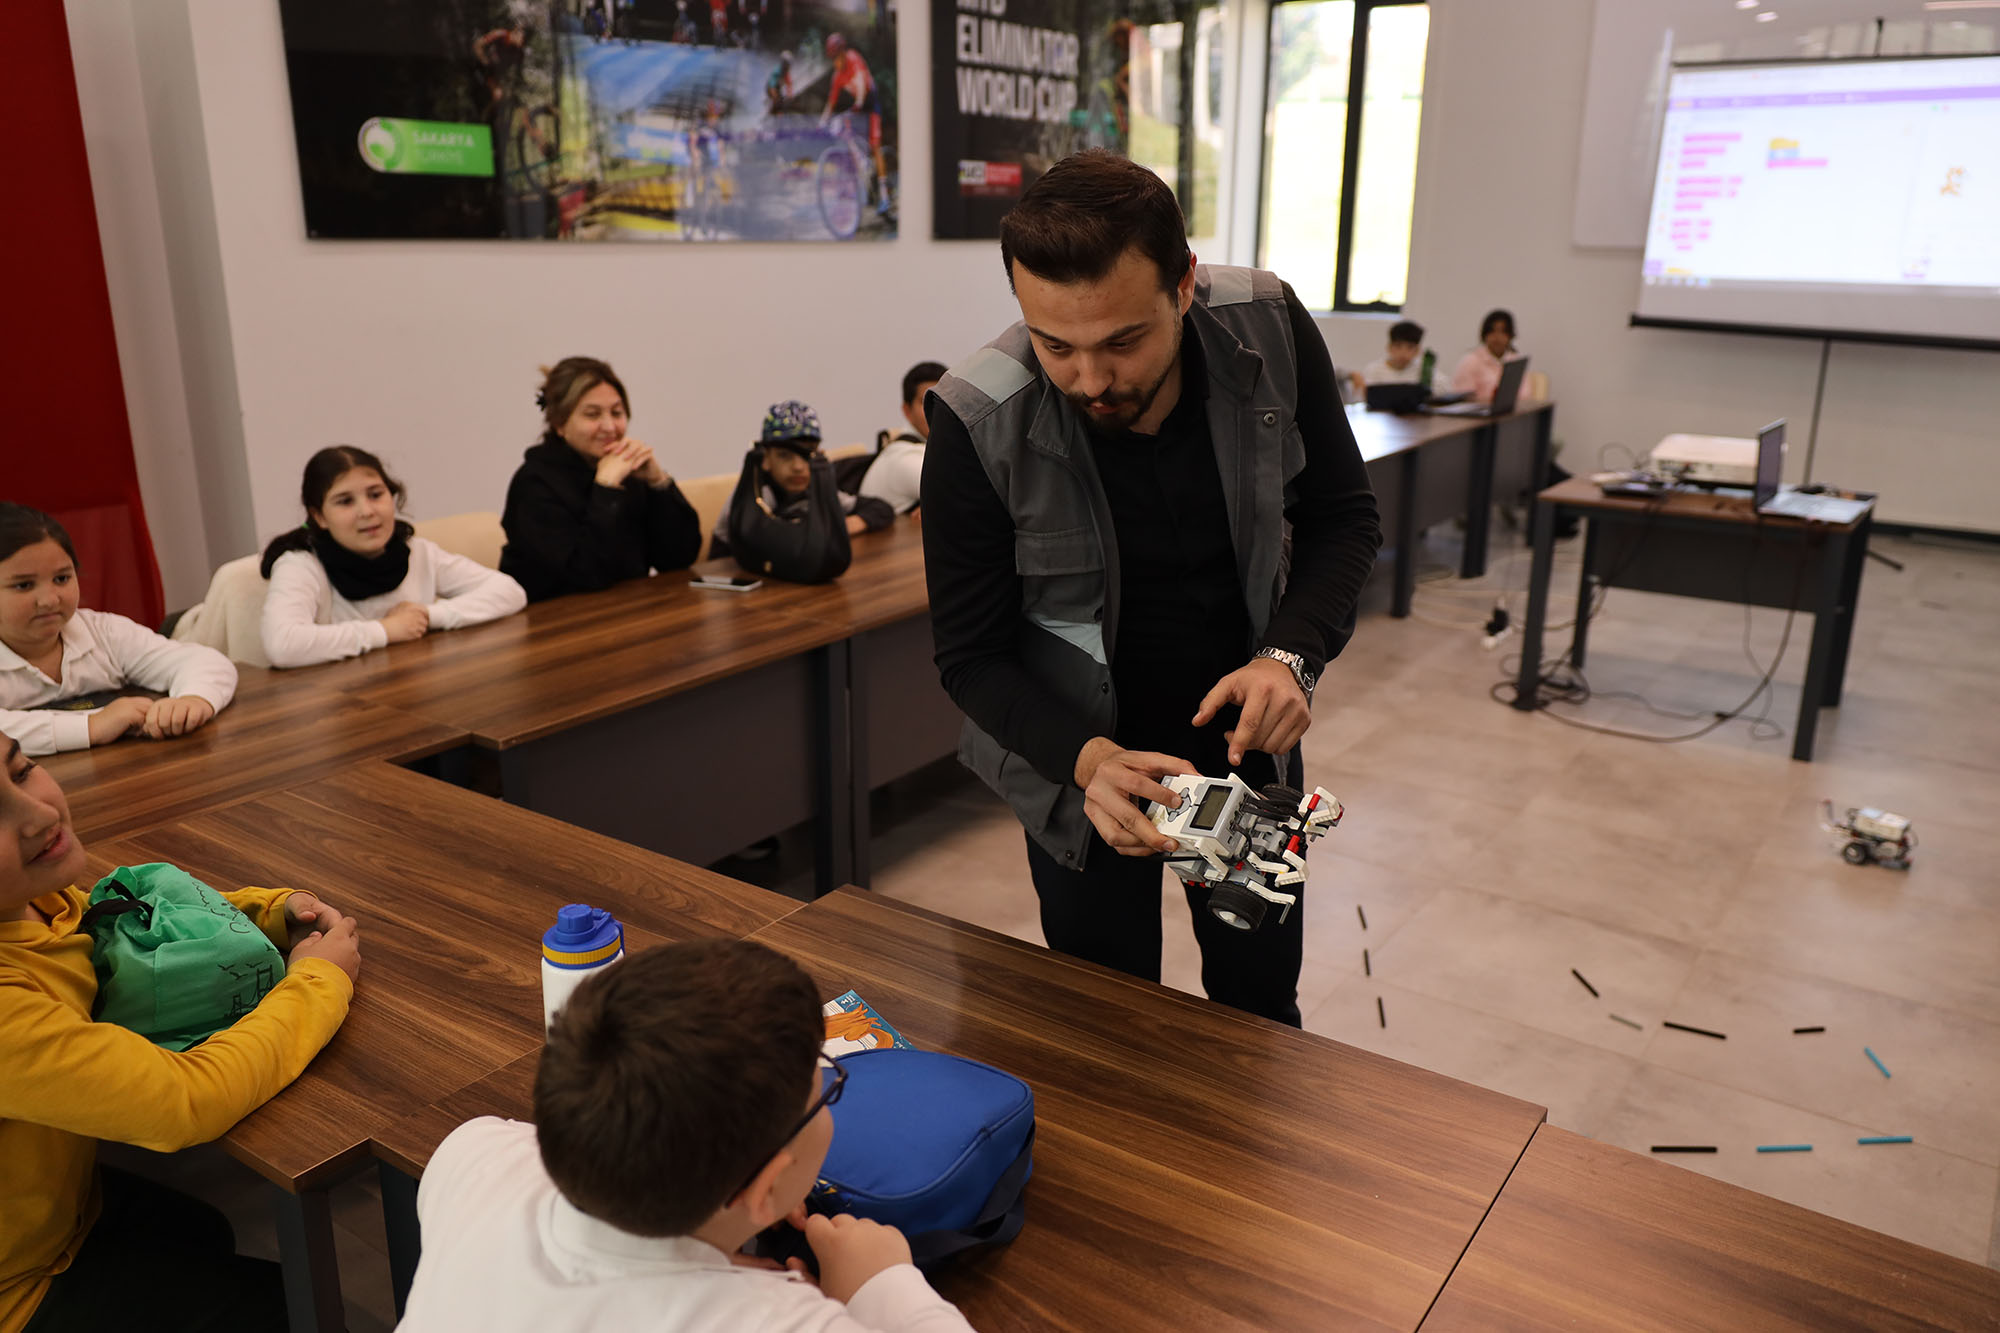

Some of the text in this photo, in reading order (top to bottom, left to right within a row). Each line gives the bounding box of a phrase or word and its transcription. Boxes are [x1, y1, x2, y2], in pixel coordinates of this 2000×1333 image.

[957, 14, 1079, 76] ELIMINATOR
[956, 66, 1078, 122] WORLD CUP
